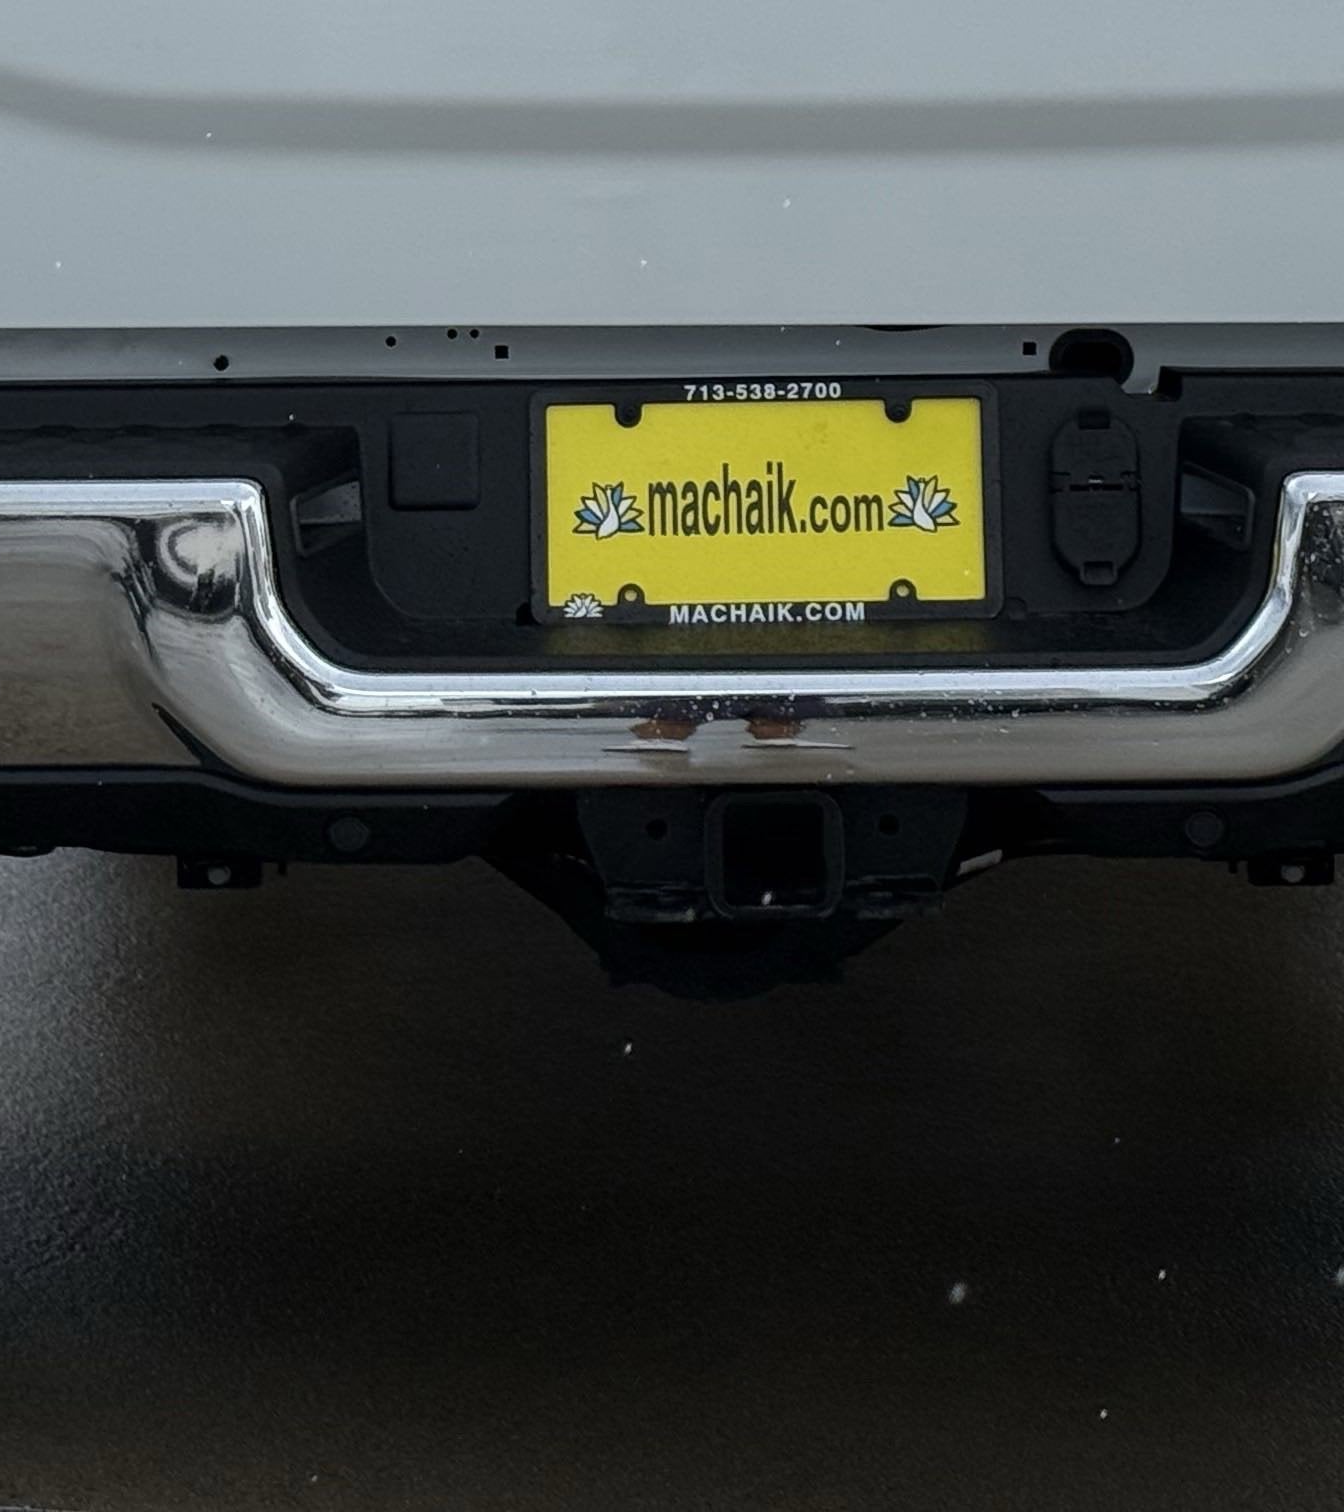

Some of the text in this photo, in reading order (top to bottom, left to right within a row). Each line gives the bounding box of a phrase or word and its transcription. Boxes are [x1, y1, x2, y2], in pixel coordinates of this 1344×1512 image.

[683, 382, 842, 401] 713-538-2700
[647, 461, 885, 537] machaik.com
[669, 601, 866, 626] MACHAIK.COM
